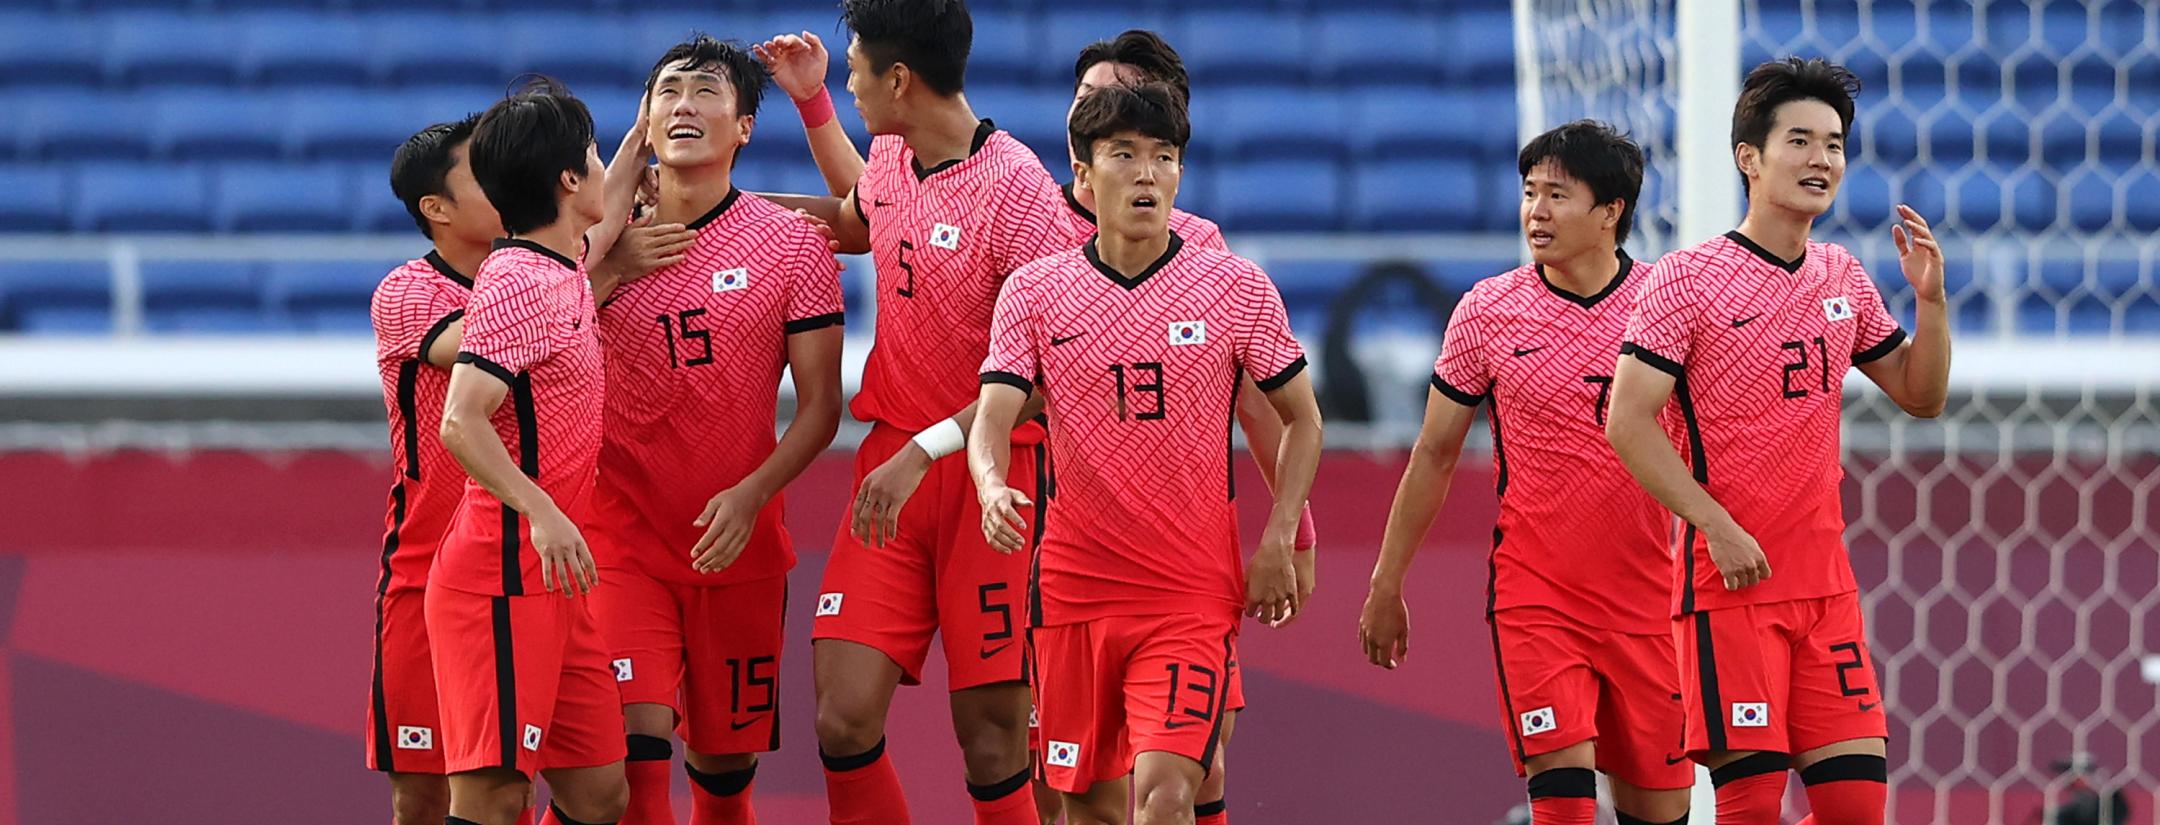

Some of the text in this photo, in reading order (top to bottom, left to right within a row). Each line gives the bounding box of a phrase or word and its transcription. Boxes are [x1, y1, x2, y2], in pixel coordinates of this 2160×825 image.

[898, 240, 913, 297] 5
[656, 308, 712, 368] 15
[1110, 362, 1165, 421] 13
[1782, 336, 1829, 399] 21
[1583, 376, 1614, 425] 7
[979, 582, 1012, 640] 5
[726, 656, 775, 713] 15
[1166, 663, 1216, 721] 13
[1829, 642, 1869, 696] 2
